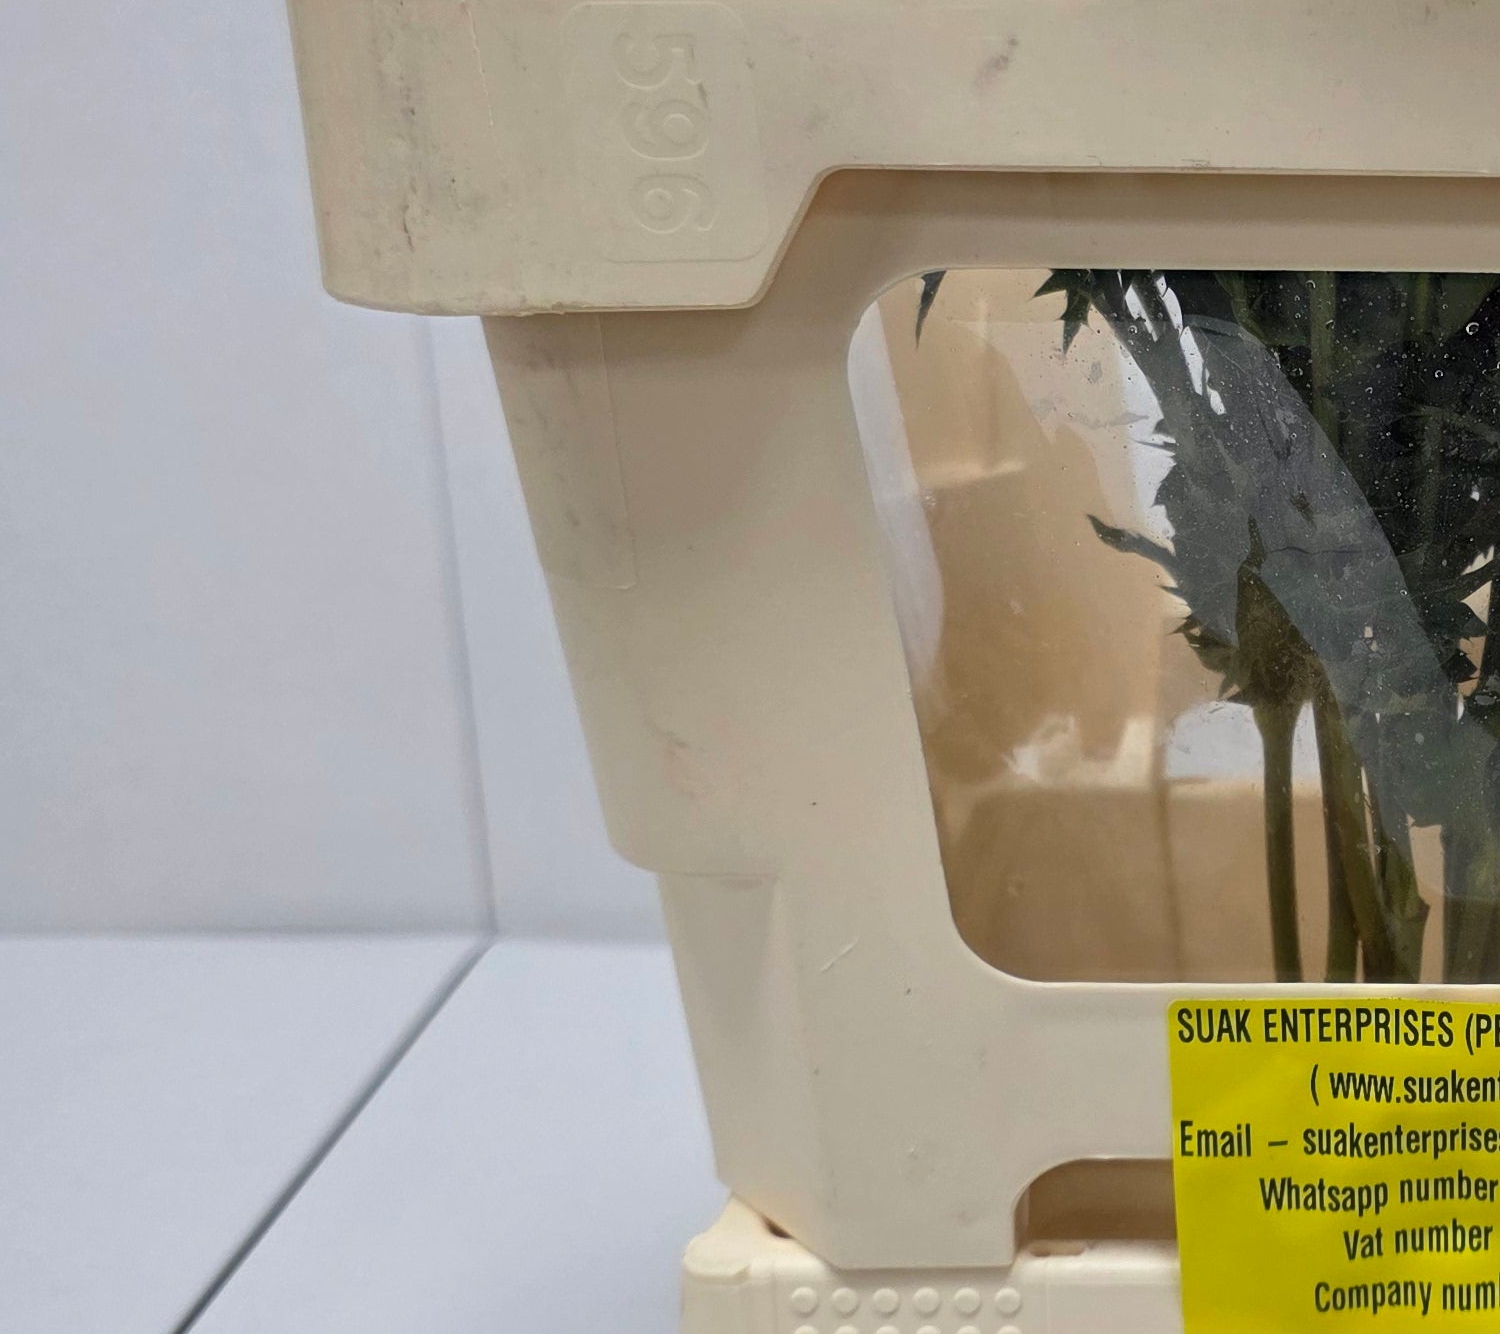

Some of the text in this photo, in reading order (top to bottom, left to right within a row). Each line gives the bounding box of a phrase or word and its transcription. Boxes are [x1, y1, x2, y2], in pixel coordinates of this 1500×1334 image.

[615, 33, 717, 234] 596
[1178, 1008, 1251, 1043] SUAK
[1264, 1008, 1453, 1047] ENTERPRISES
[1180, 1120, 1251, 1158] Email
[1259, 1177, 1388, 1217] Whatsapp
[1400, 1173, 1499, 1204] number
[1343, 1228, 1383, 1260] Vat
[1395, 1218, 1493, 1254] number
[1315, 1281, 1432, 1316] Company
